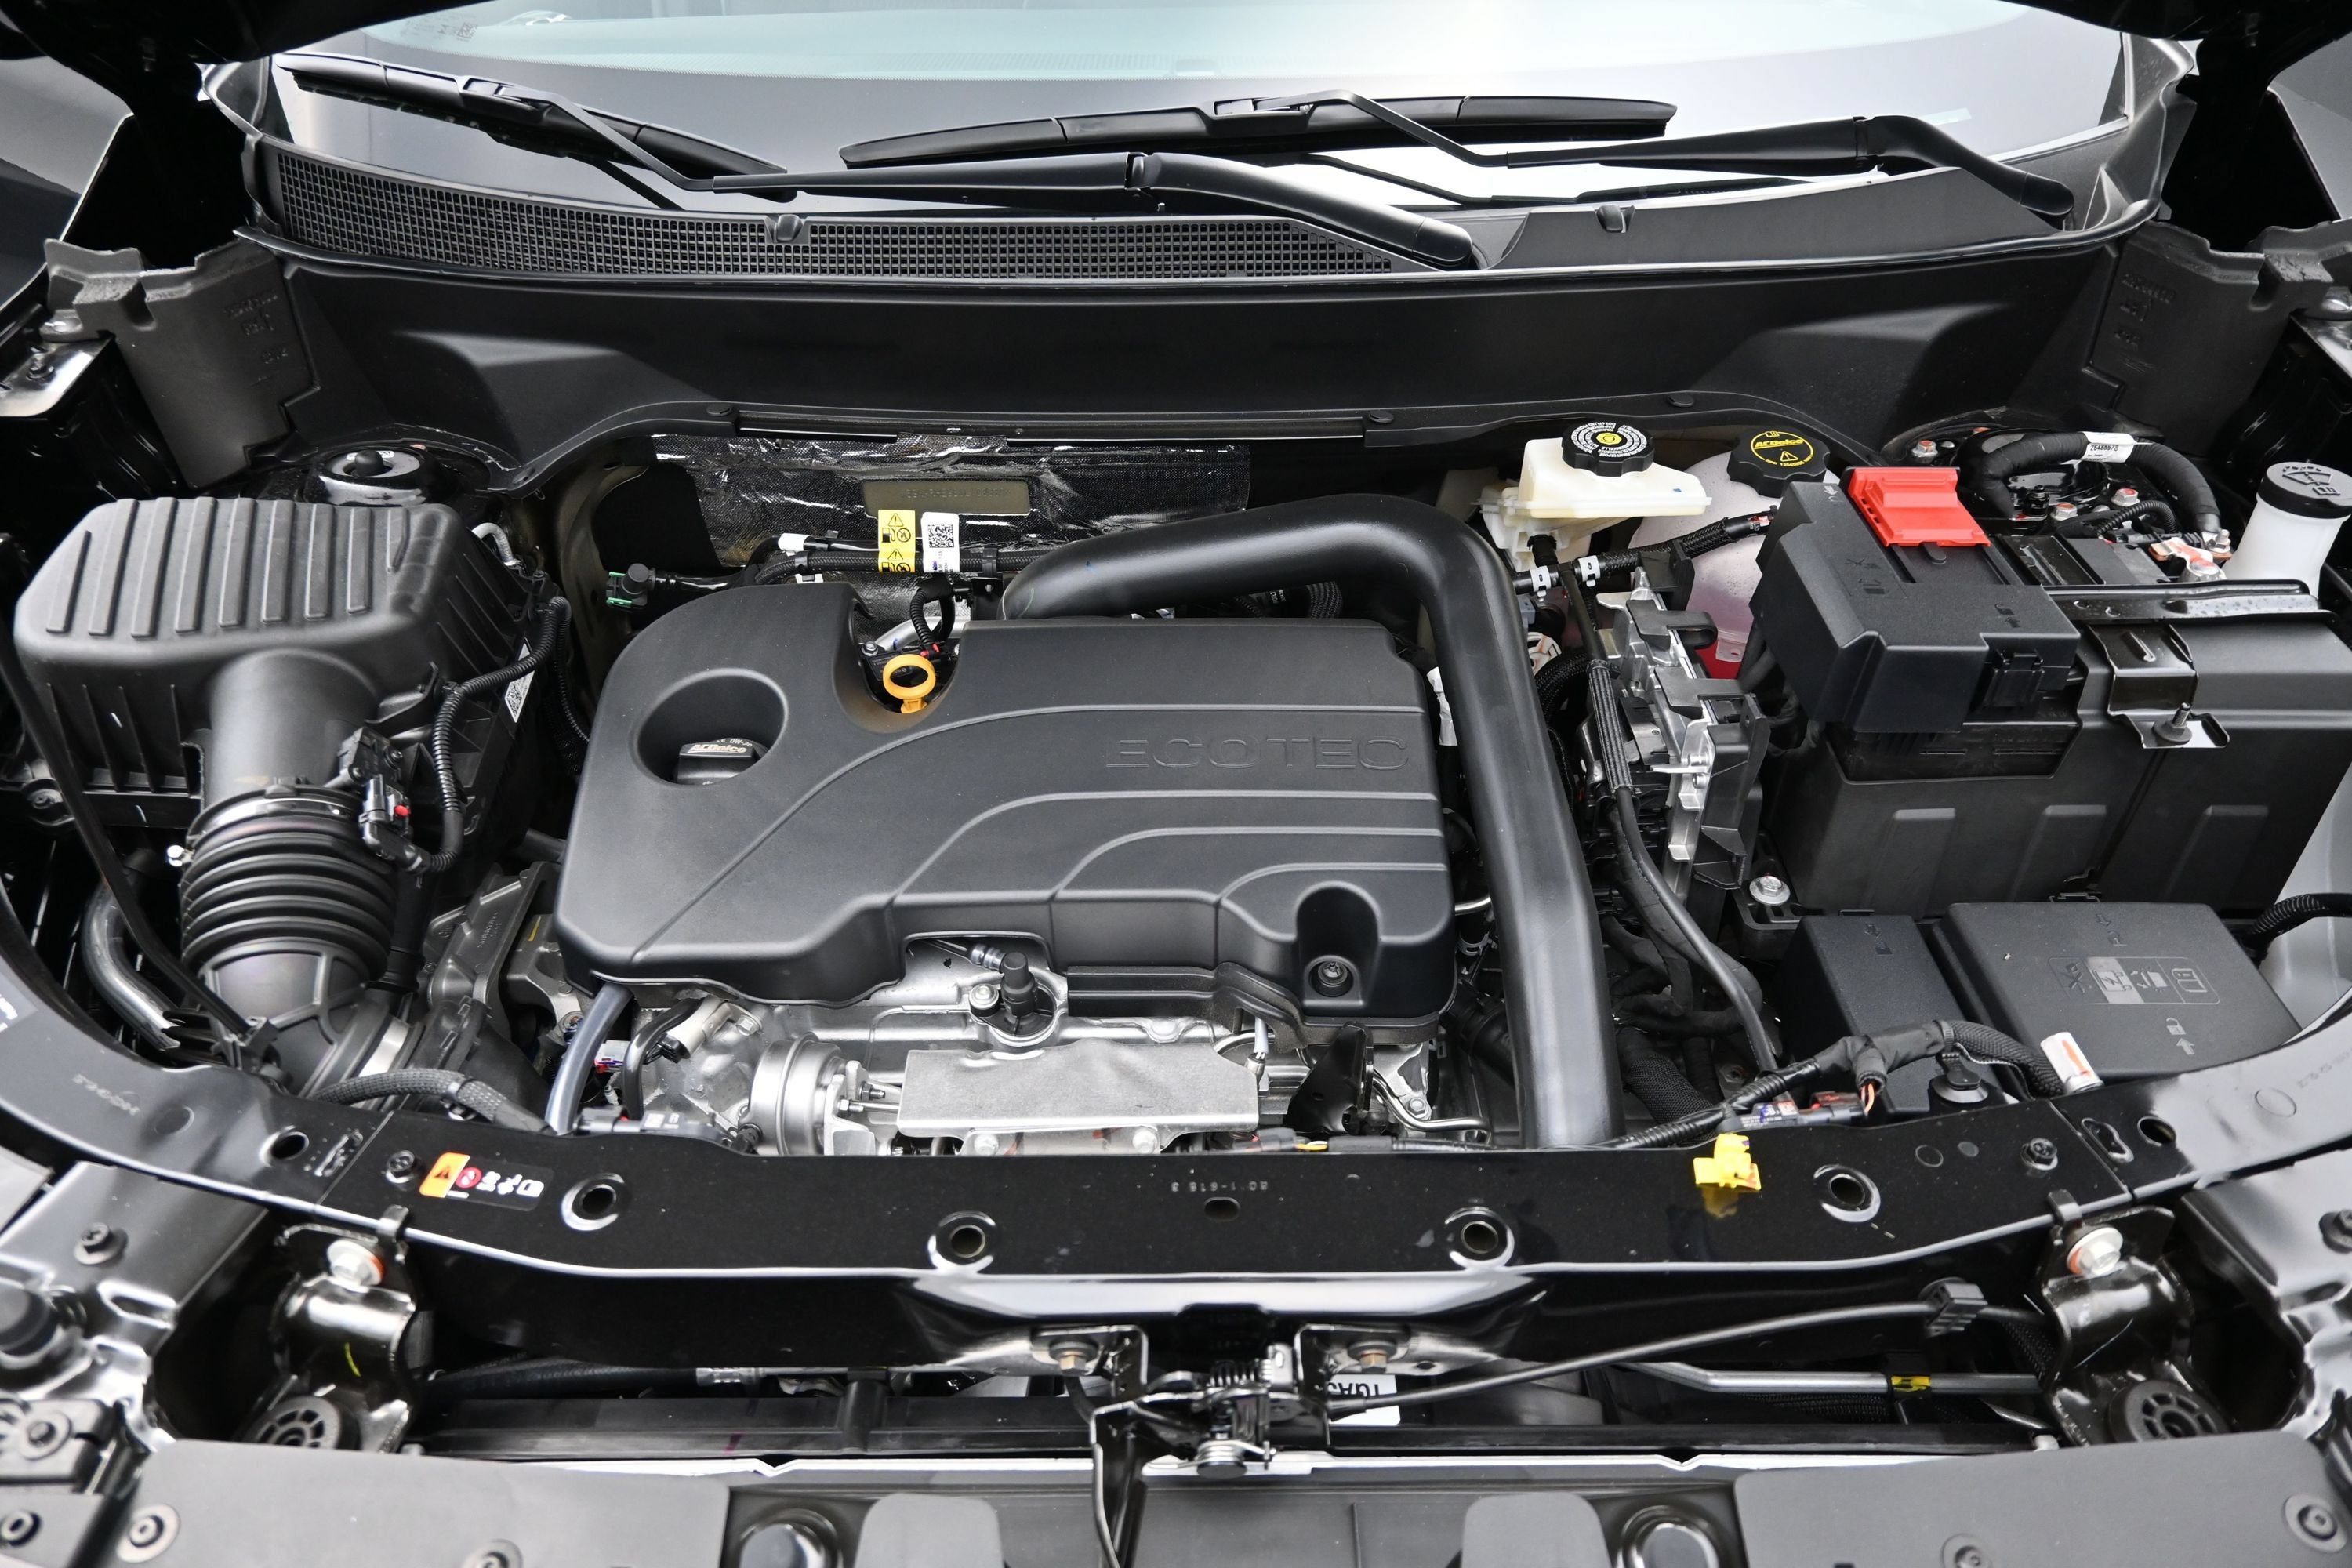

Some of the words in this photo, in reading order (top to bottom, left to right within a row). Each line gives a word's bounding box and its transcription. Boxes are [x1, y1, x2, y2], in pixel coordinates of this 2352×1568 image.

[1755, 439, 1804, 449] ACDelco
[687, 743, 747, 753] ACDelco
[1105, 736, 1409, 770] ECOTEC
